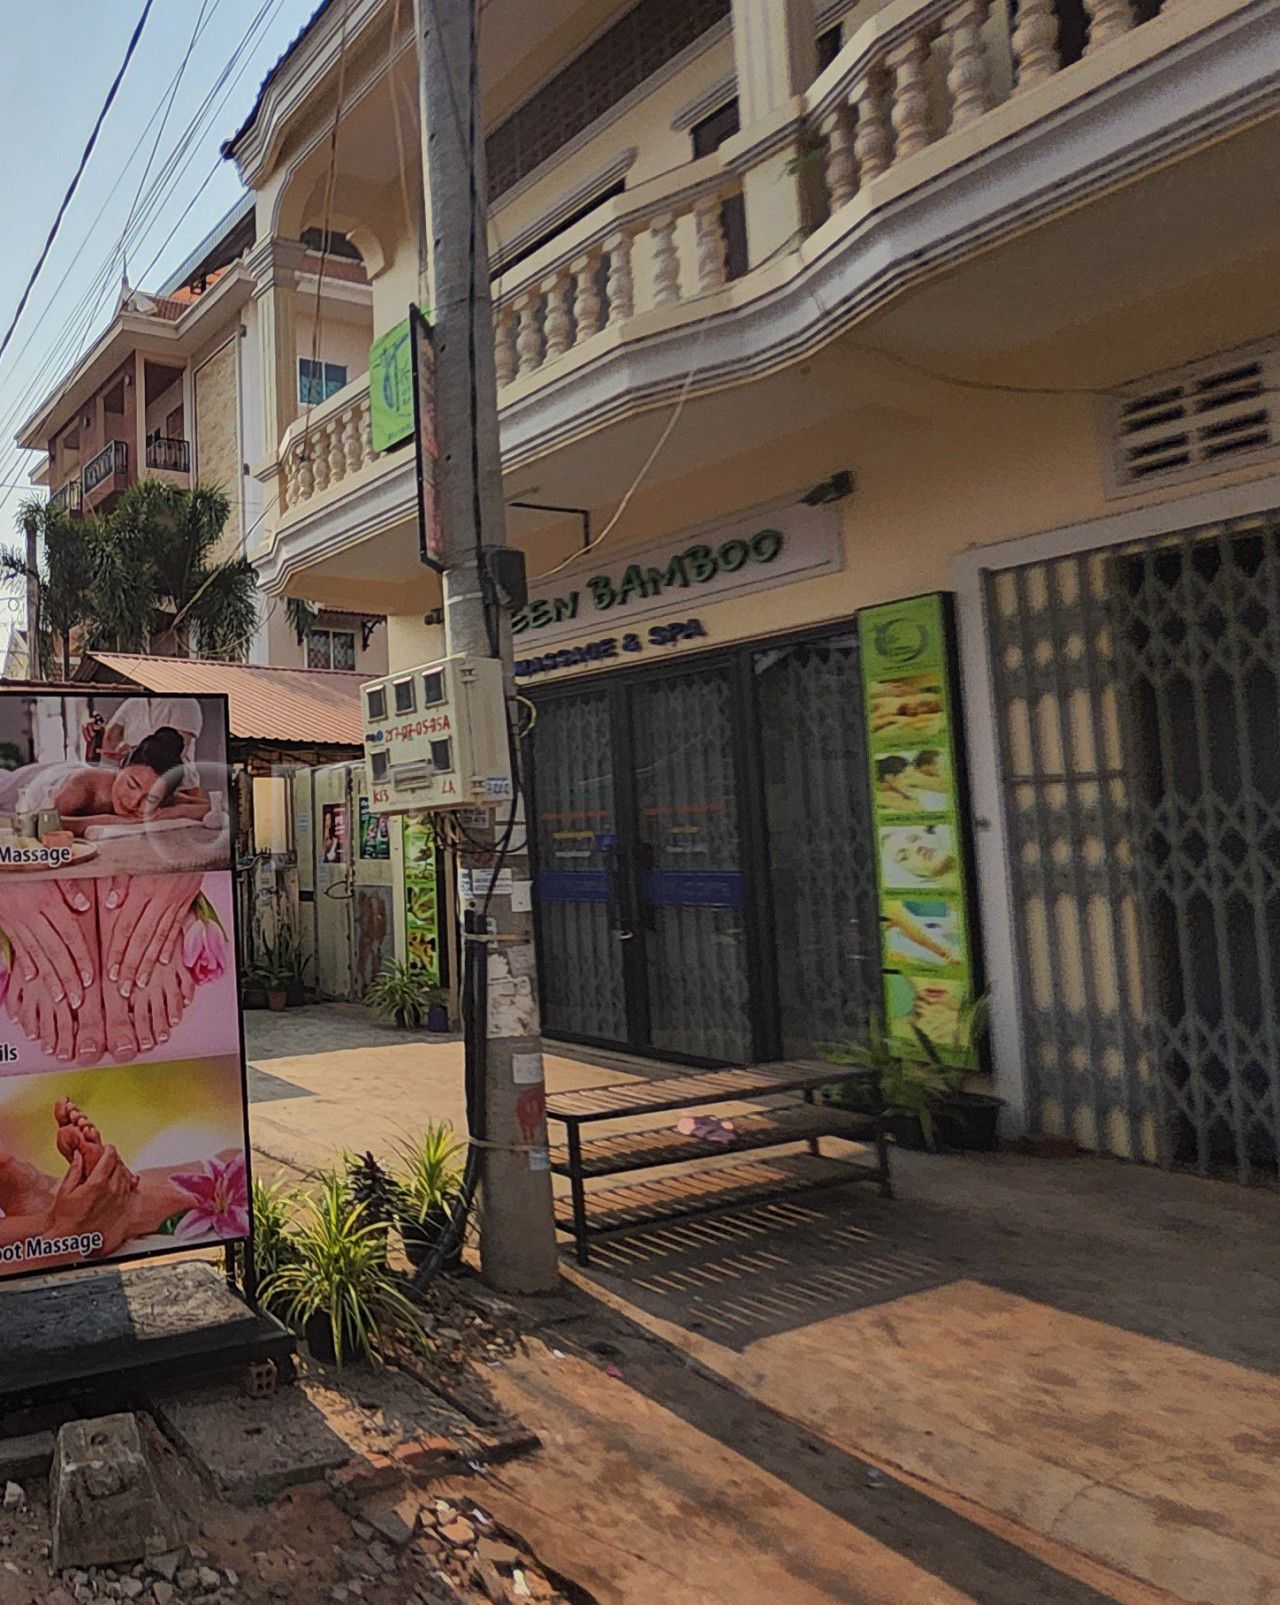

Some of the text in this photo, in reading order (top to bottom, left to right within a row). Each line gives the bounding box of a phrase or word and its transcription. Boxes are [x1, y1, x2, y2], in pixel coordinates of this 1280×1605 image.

[586, 529, 783, 609] BAMBOO
[622, 633, 642, 652] &
[648, 618, 707, 646] SPA
[26, 1232, 102, 1258] Massage
